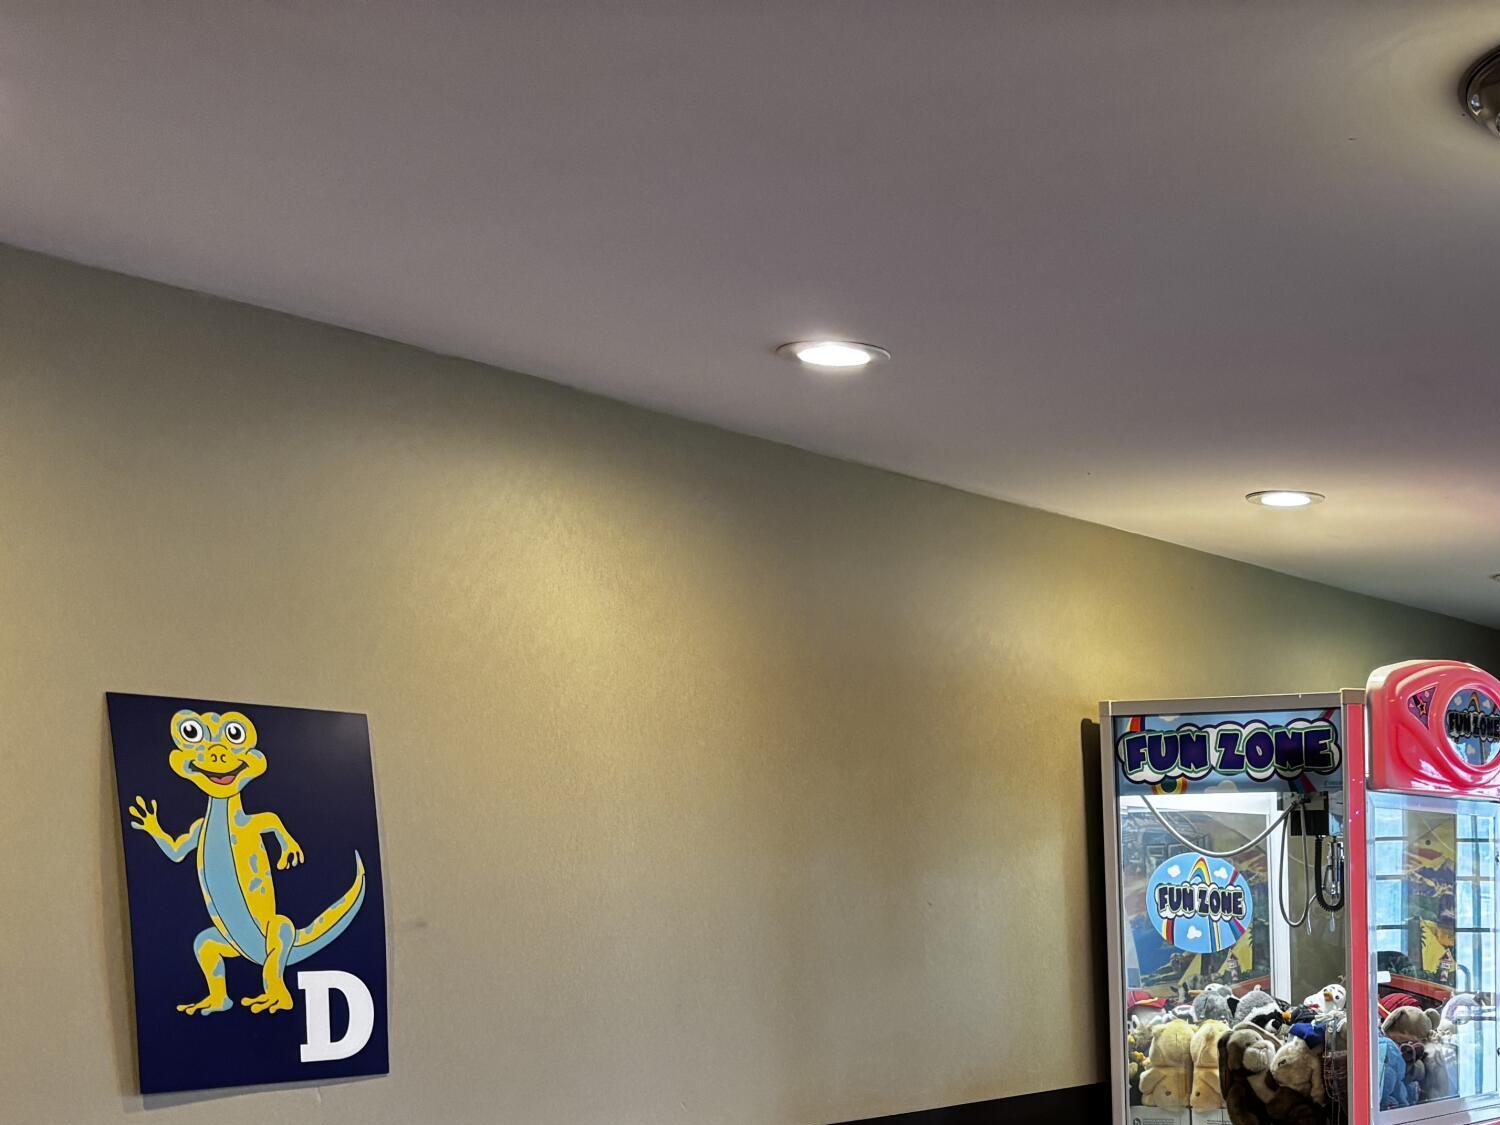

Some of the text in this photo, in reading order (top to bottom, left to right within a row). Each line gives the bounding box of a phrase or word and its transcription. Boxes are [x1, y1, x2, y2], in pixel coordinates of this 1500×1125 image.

[1448, 711, 1500, 738] FUN ZONE
[1124, 727, 1336, 773] FUN ZONE
[1158, 886, 1243, 916] FUN ZONE
[297, 969, 375, 1063] D
